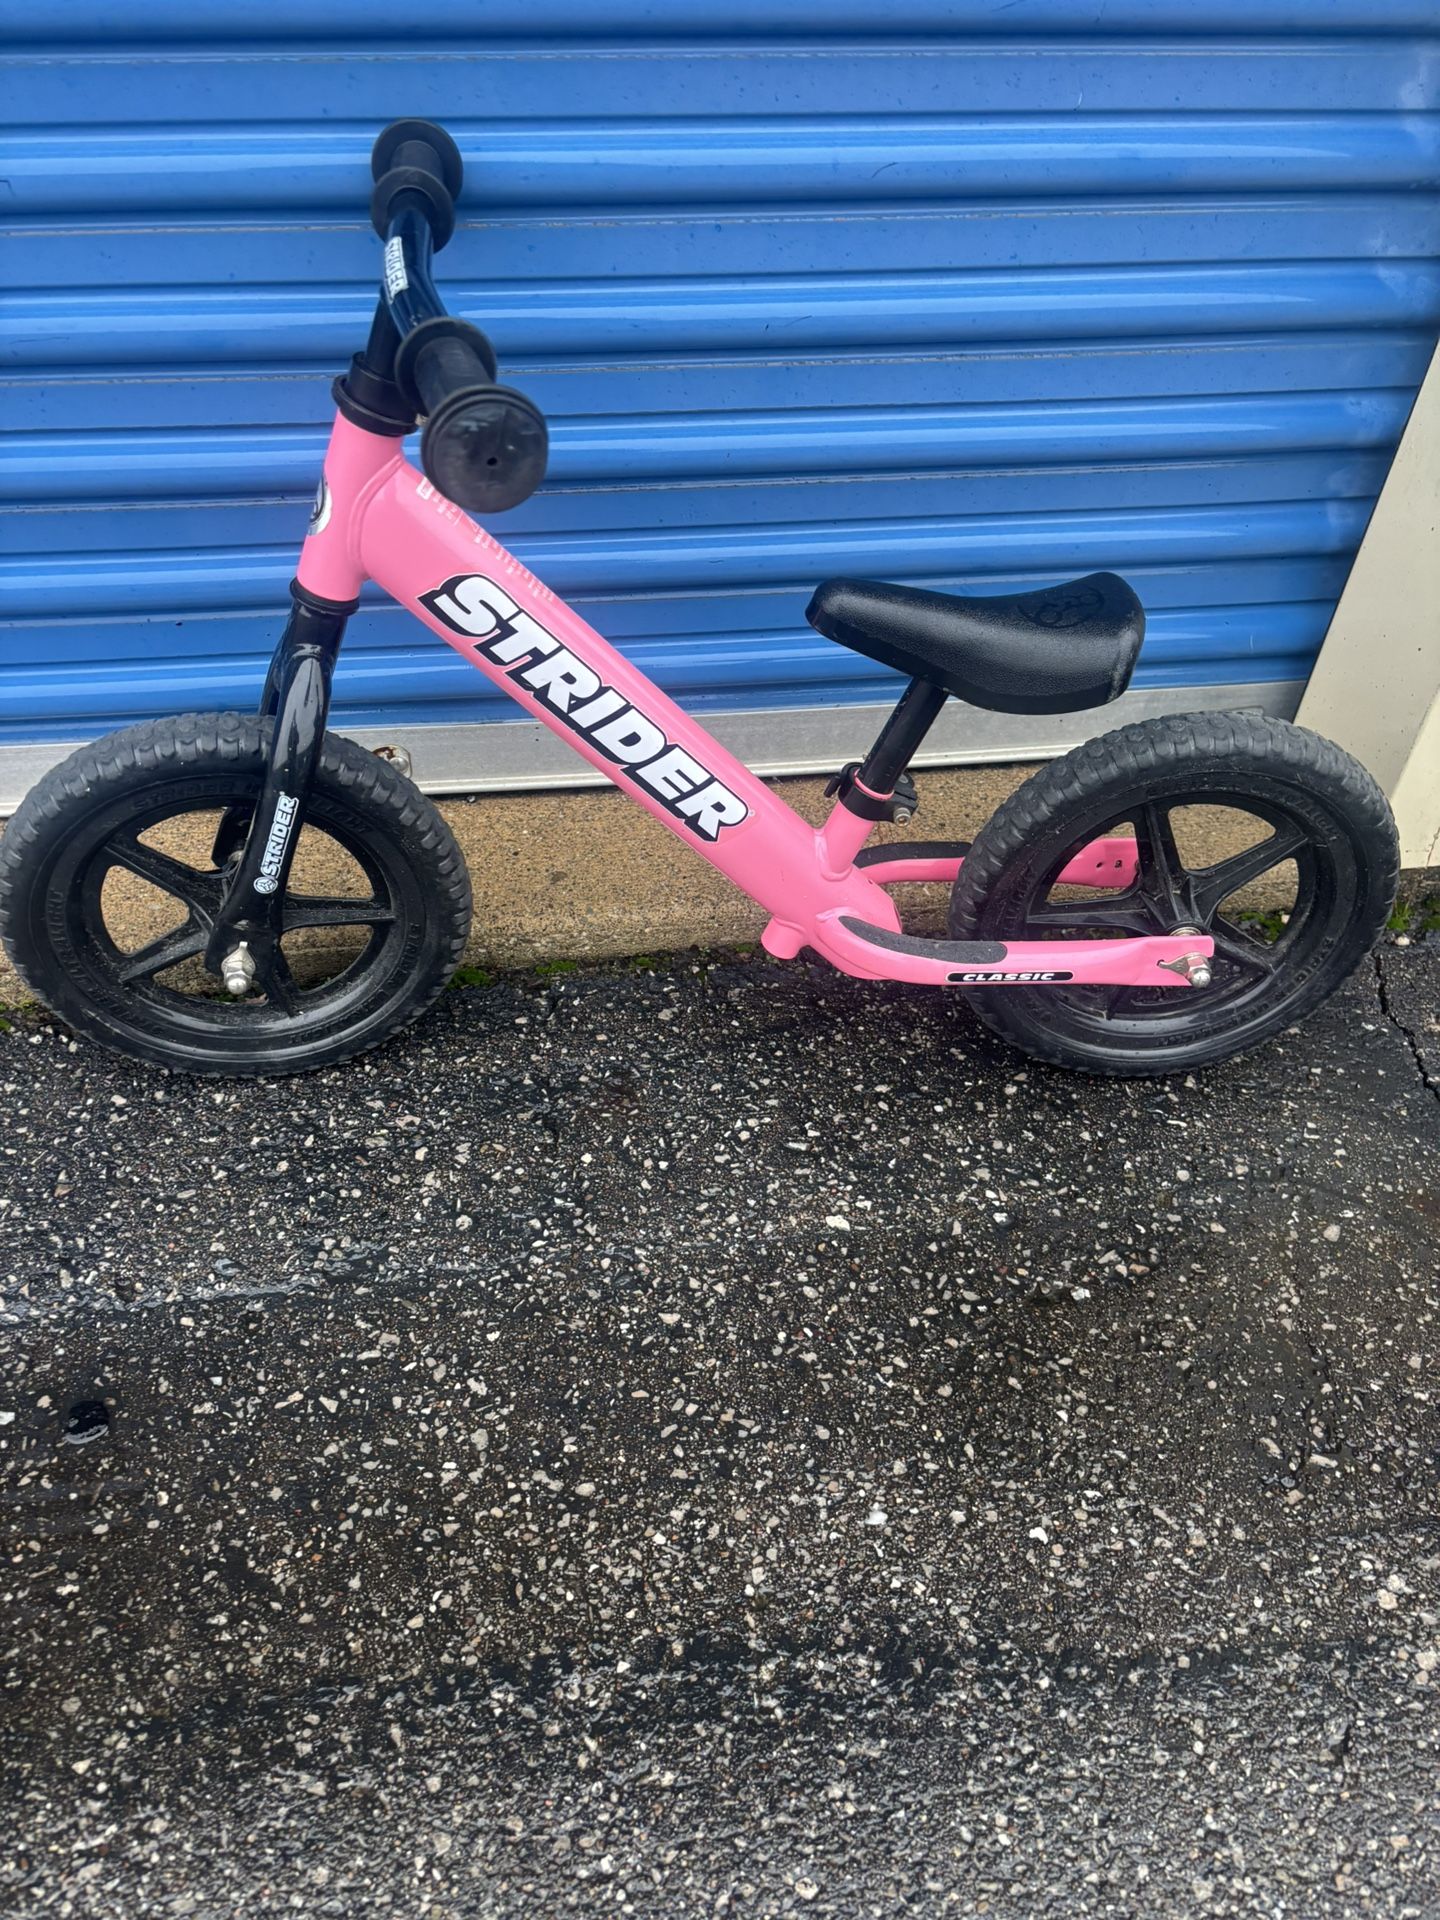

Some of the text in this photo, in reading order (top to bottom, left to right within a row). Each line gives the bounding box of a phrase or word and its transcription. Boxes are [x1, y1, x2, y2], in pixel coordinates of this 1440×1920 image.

[420, 573, 750, 842] STRIDER
[262, 795, 299, 878] STRIDER
[962, 973, 1055, 981] CLASSIC
